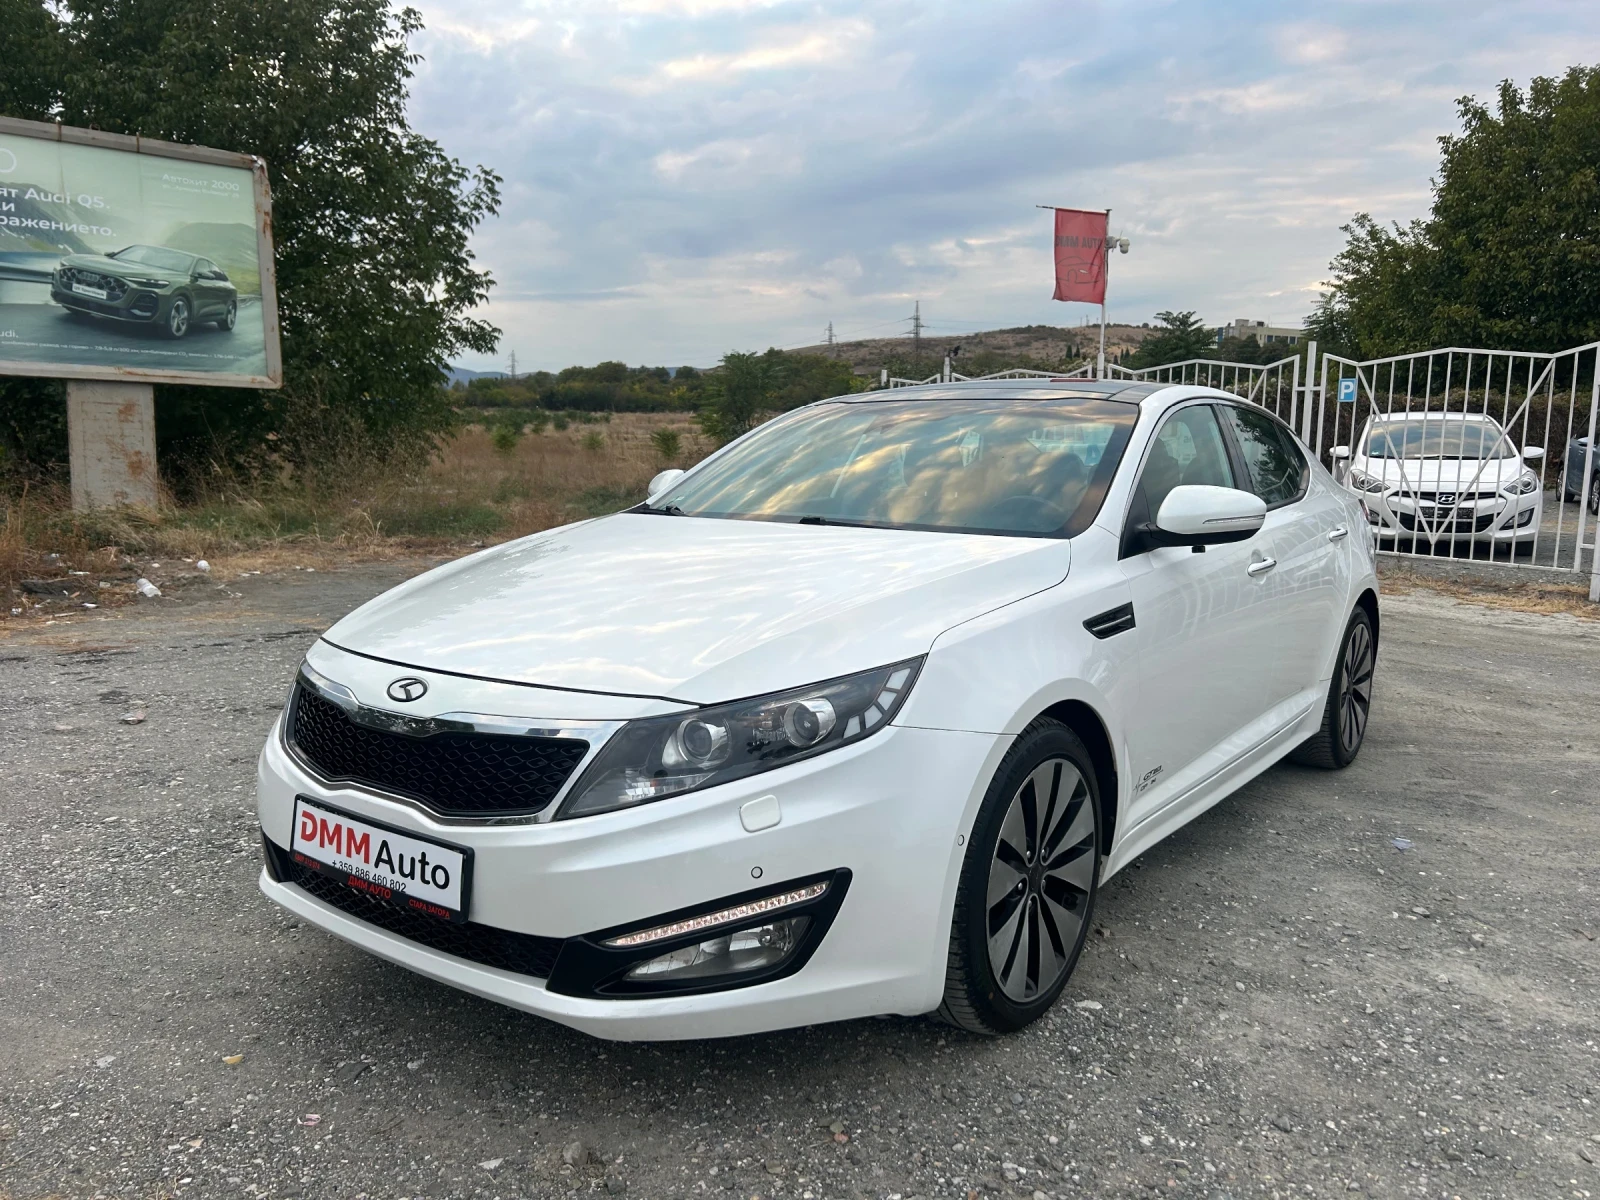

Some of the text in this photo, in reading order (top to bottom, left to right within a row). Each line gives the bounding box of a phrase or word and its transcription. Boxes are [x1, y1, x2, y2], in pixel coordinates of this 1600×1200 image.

[161, 173, 208, 186] Автохит
[211, 179, 240, 191] 2000
[24, 187, 71, 205] Audi
[1341, 381, 1354, 399] P
[347, 875, 391, 898] ДММ АУТО
[355, 866, 370, 880] 886
[372, 873, 388, 887] 460
[389, 879, 407, 893] 802
[408, 899, 450, 919] СТАРА ЗАГОРА
